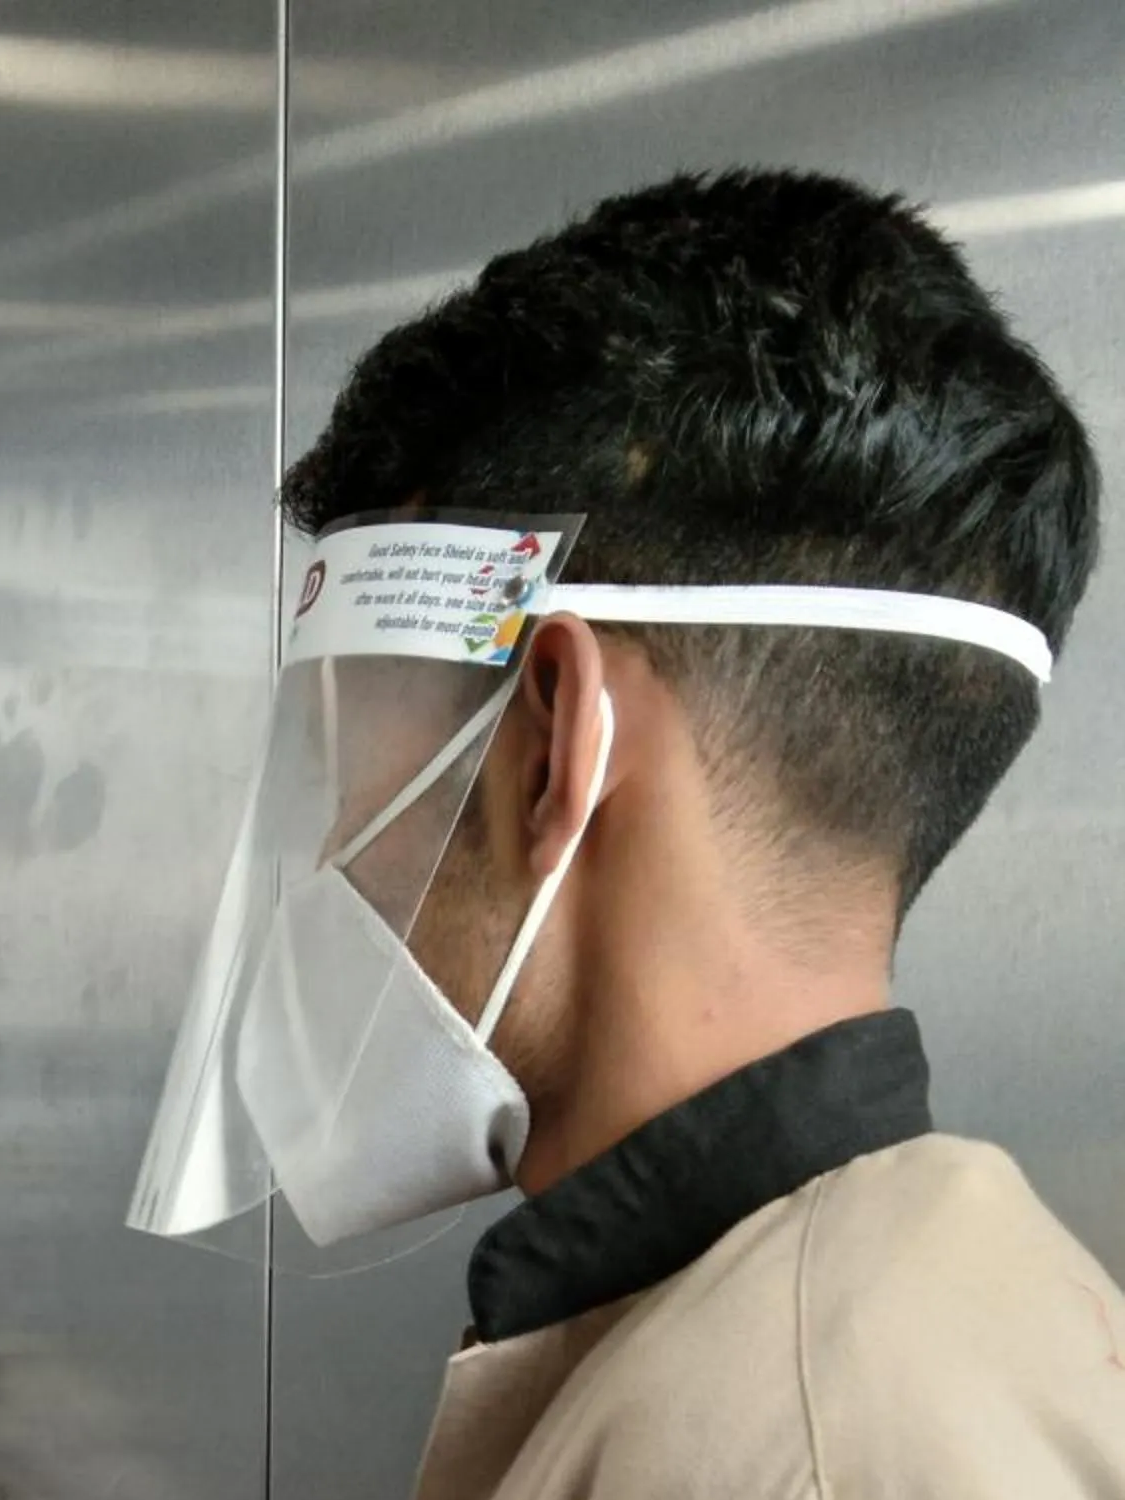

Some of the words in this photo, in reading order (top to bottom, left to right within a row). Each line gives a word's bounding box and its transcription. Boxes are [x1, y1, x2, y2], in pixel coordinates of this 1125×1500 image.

[418, 542, 442, 557] Face
[443, 543, 475, 560] Shield
[439, 572, 467, 586] your
